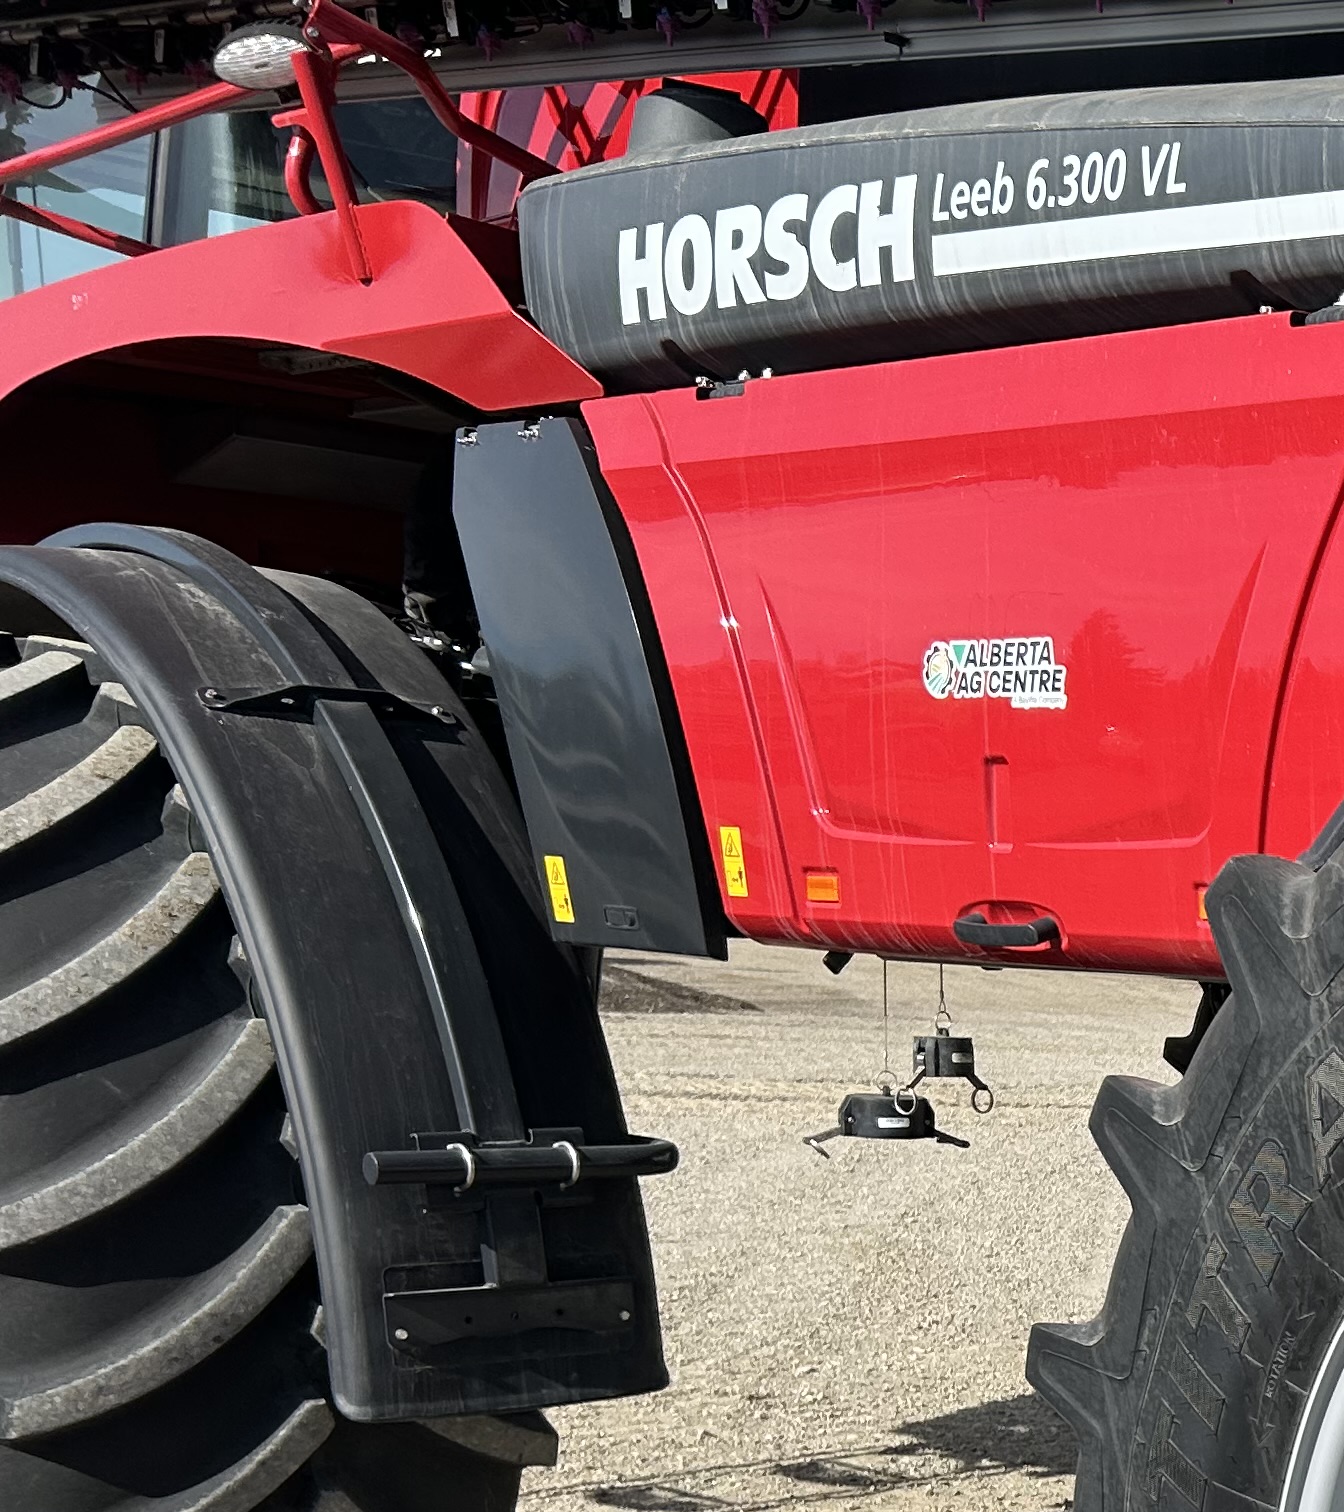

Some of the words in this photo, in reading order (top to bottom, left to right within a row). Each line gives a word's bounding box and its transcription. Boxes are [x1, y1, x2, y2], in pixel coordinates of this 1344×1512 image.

[931, 170, 1015, 224] Leeb
[1026, 146, 1127, 208] 6.300
[1138, 141, 1188, 195] VL
[619, 173, 917, 326] HORSCH
[956, 672, 982, 694] AG
[989, 669, 1063, 694] CENTRE
[964, 640, 1052, 668] ALBERTA
